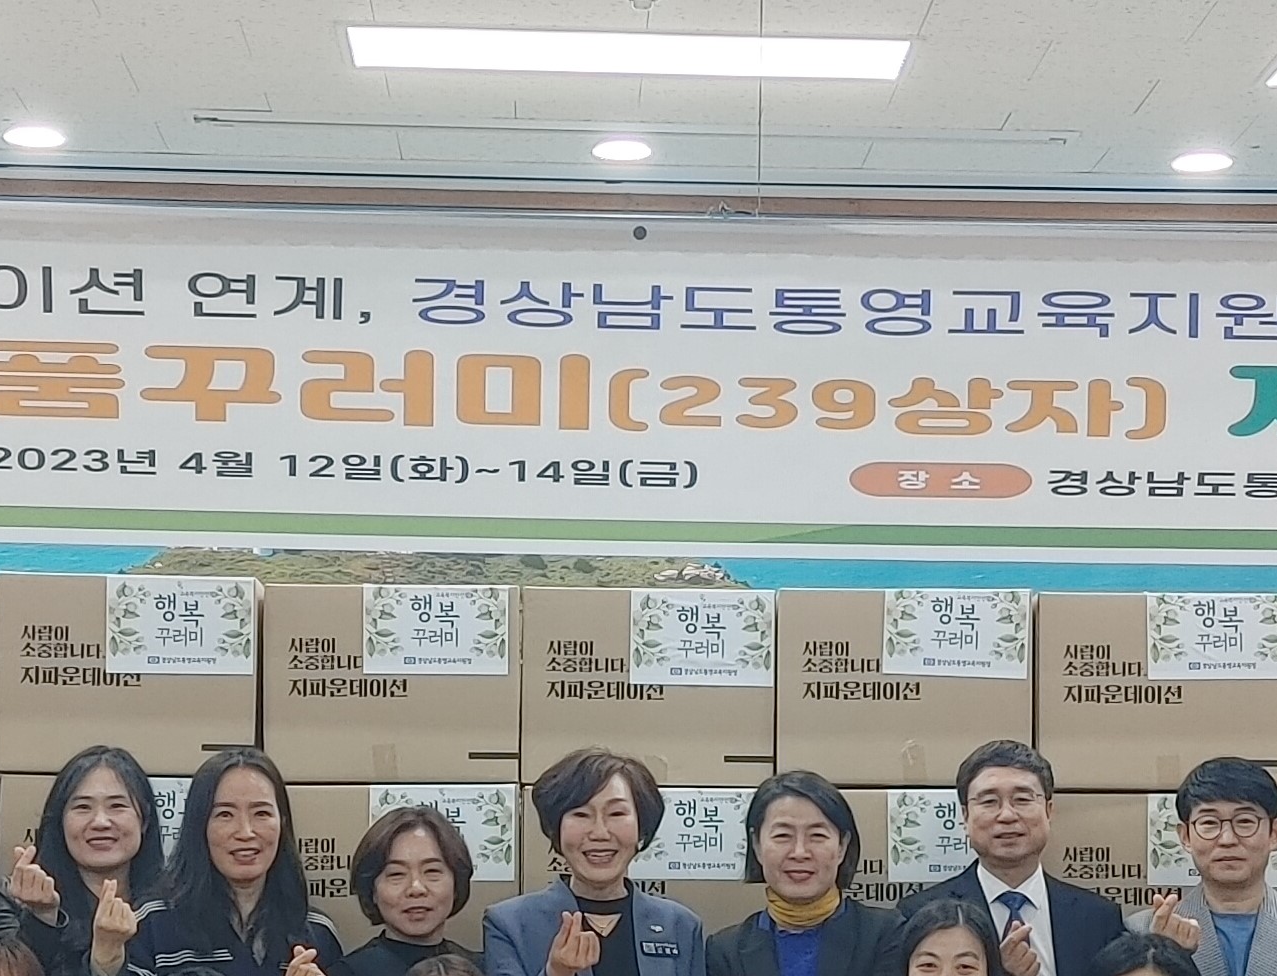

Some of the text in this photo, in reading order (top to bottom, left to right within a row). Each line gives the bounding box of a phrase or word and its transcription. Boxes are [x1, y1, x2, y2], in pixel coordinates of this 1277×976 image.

[186, 268, 372, 325] 연계,
[179, 449, 257, 477] 4월
[280, 450, 700, 490] 12일(화)~14일(금)
[153, 593, 205, 628] 행복
[409, 594, 460, 628] 행복
[931, 596, 980, 630] 행복
[1193, 599, 1244, 633] 행복
[677, 605, 726, 640] 행복
[20, 625, 69, 642] 사람이
[155, 627, 203, 647] 꾸러미
[411, 628, 459, 648] 꾸러미
[931, 630, 979, 650] 꾸러미
[1195, 632, 1243, 652] 꾸러미
[288, 638, 335, 654] 사람이
[546, 640, 594, 657] 사람이
[678, 639, 725, 659] 꾸러미
[803, 641, 850, 657] 사람이
[1064, 644, 1111, 660] 사람이
[288, 679, 408, 698] 지파운데이션
[802, 681, 921, 701] 지파운데이션
[1063, 685, 1183, 705] 지파운데이션
[674, 799, 725, 833] 행복
[676, 833, 723, 853] 꾸러미
[935, 836, 967, 855] 꾸러
[304, 855, 351, 871] 중합니
[1063, 846, 1110, 863] 사람이
